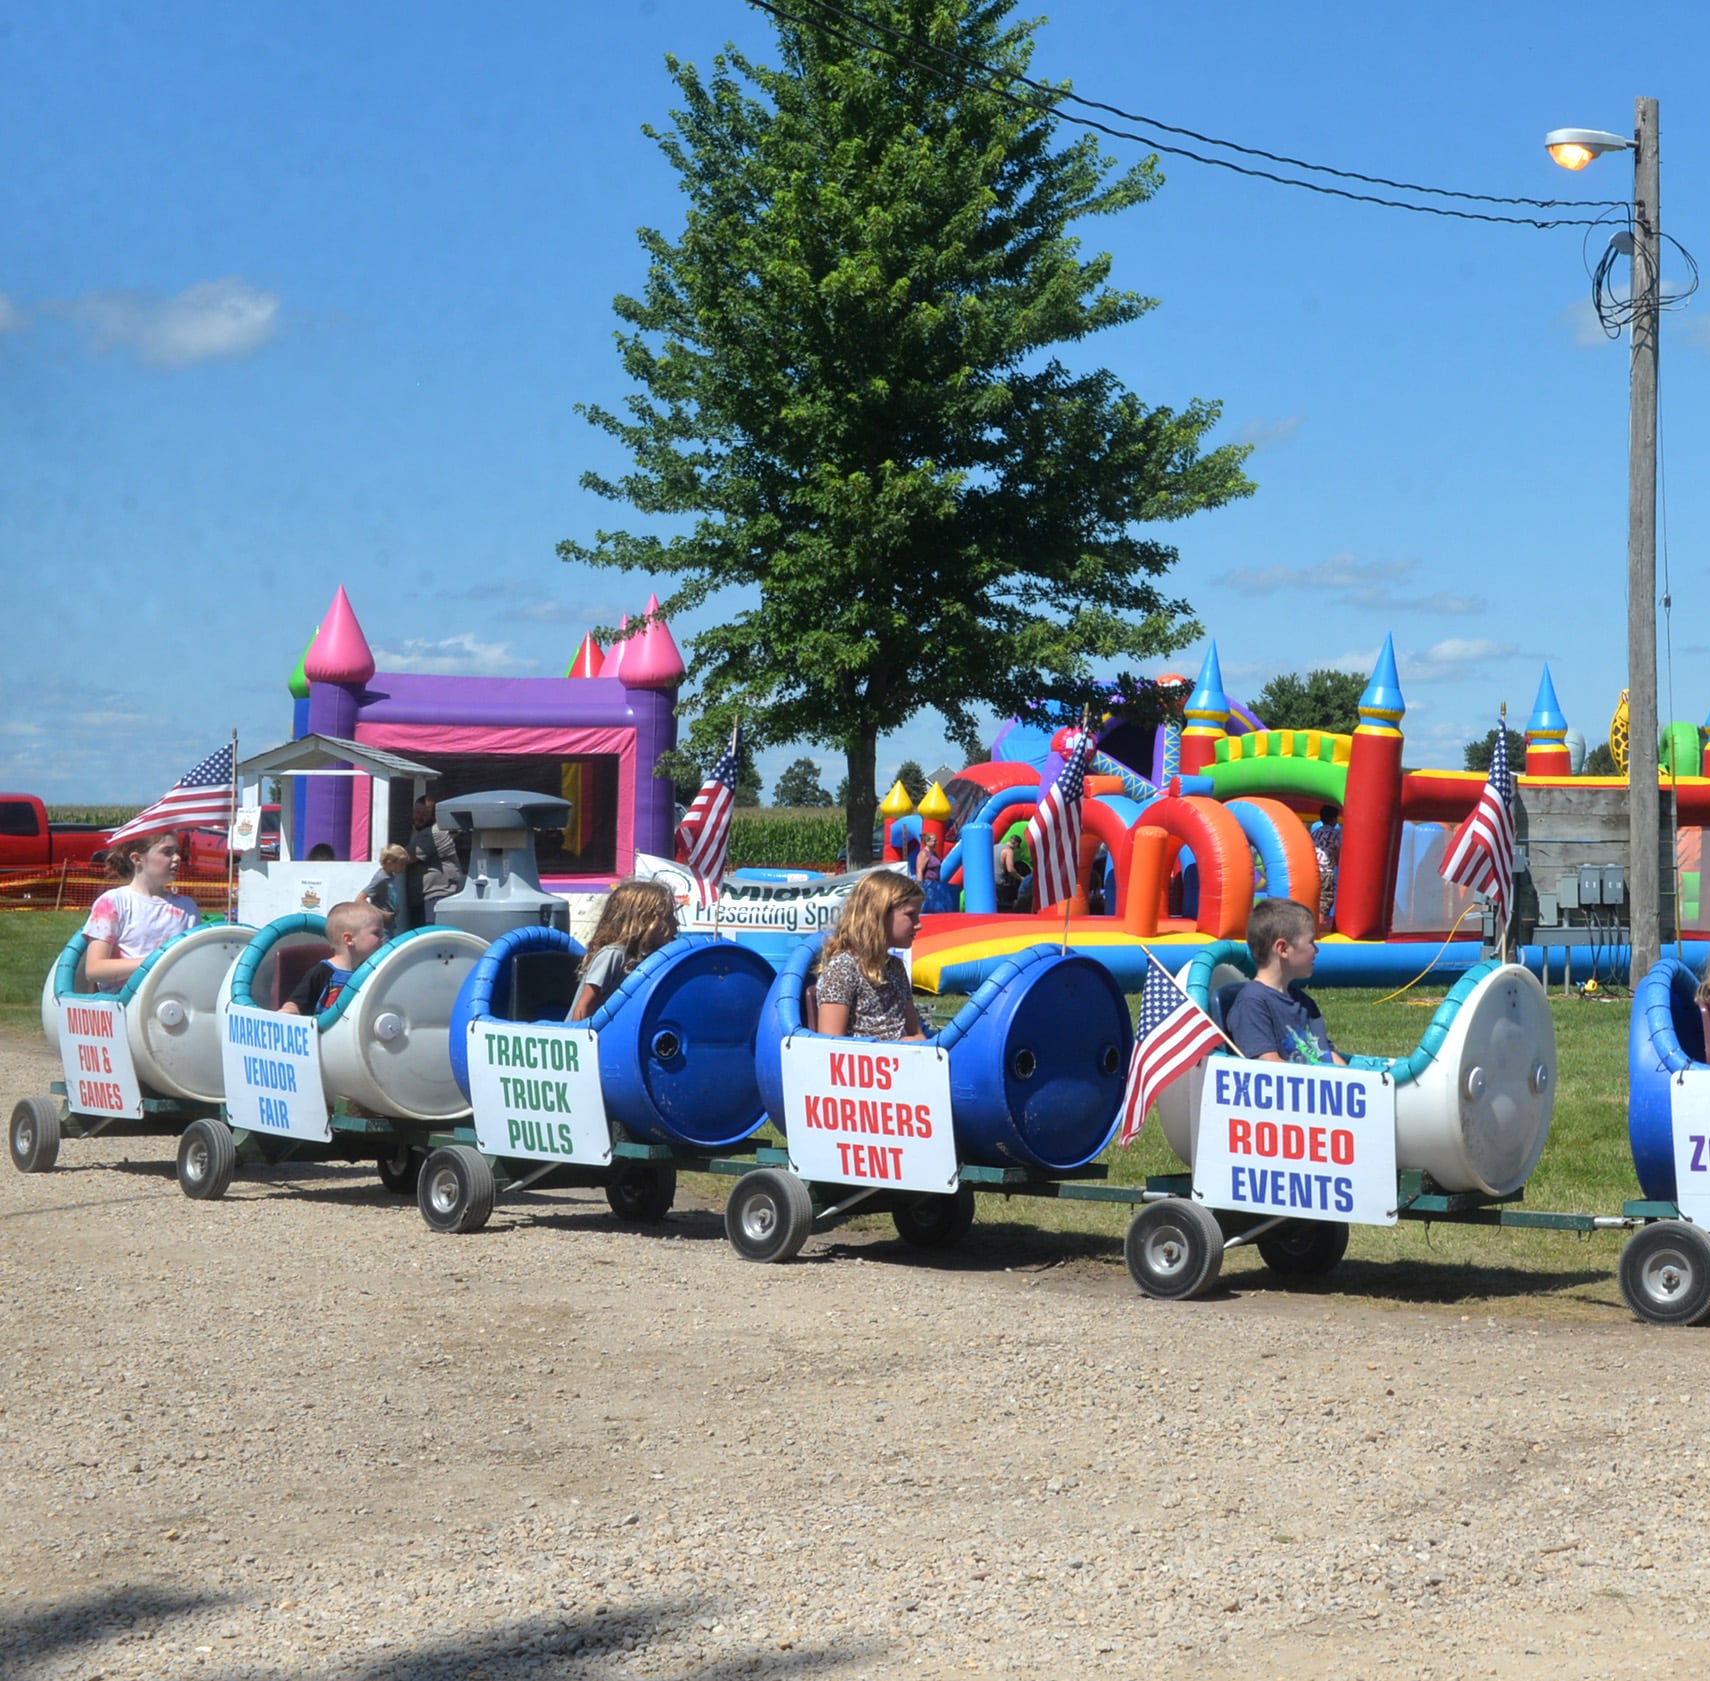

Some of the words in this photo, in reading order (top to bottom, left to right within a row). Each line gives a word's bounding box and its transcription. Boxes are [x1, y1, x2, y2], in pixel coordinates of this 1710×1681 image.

[696, 901, 797, 931] Presenting
[67, 1008, 115, 1038] MIDWAY
[229, 1014, 309, 1056] MARKETPLACE
[78, 1044, 101, 1073] FUN
[102, 1047, 112, 1074] &
[485, 1033, 579, 1072] TRACTOR
[830, 1052, 900, 1090] KIDS'
[244, 1055, 297, 1093] VENDOR
[79, 1080, 124, 1111] GAMES
[258, 1096, 290, 1129] FAIR
[500, 1077, 572, 1113] TRUCK
[1215, 1069, 1366, 1119] EXCITING
[804, 1095, 932, 1139] KORNERS
[507, 1119, 574, 1155] PULLS
[1228, 1118, 1355, 1166] RODEO
[836, 1142, 904, 1180] TENT
[1231, 1166, 1354, 1213] EVENTS
